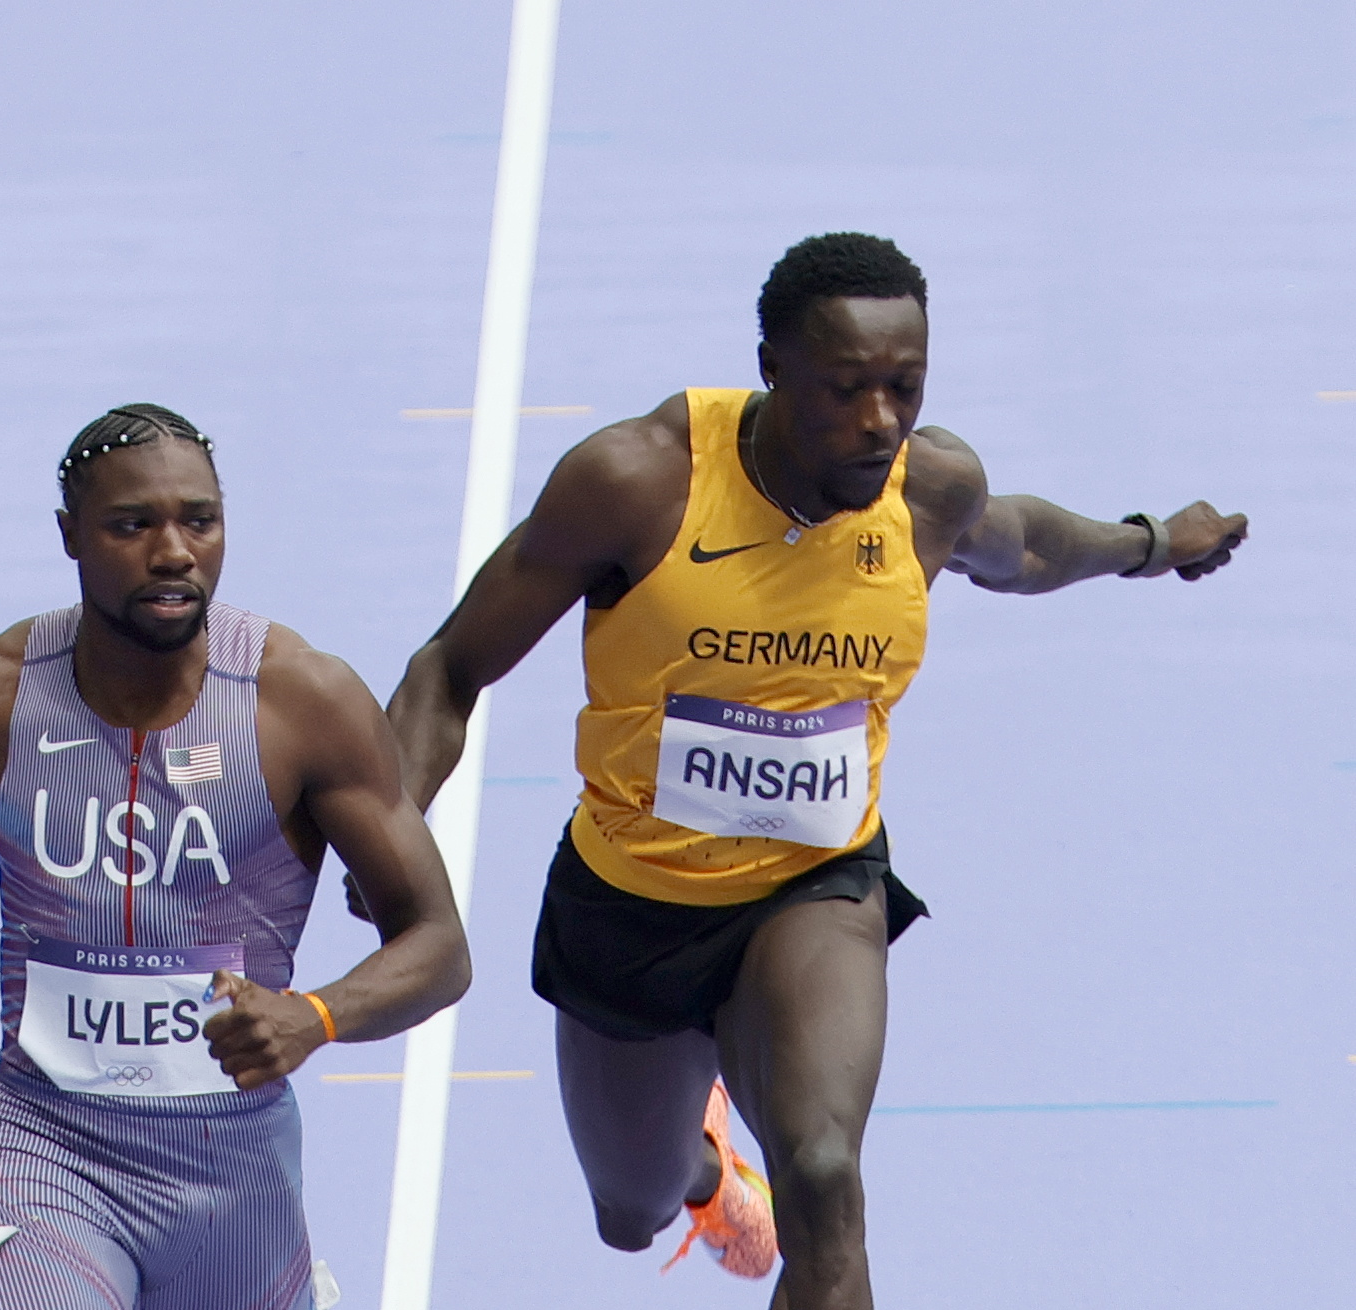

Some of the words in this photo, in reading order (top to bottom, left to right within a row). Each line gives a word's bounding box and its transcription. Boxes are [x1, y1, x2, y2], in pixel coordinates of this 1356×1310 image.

[688, 627, 893, 669] GERMANY
[722, 707, 777, 730] PARIS
[782, 714, 825, 732] 2024
[683, 746, 848, 801] ANSAH
[34, 788, 231, 887] USA
[76, 950, 128, 968] PARIS
[135, 954, 185, 968] 2024
[68, 994, 200, 1046] LYLES
